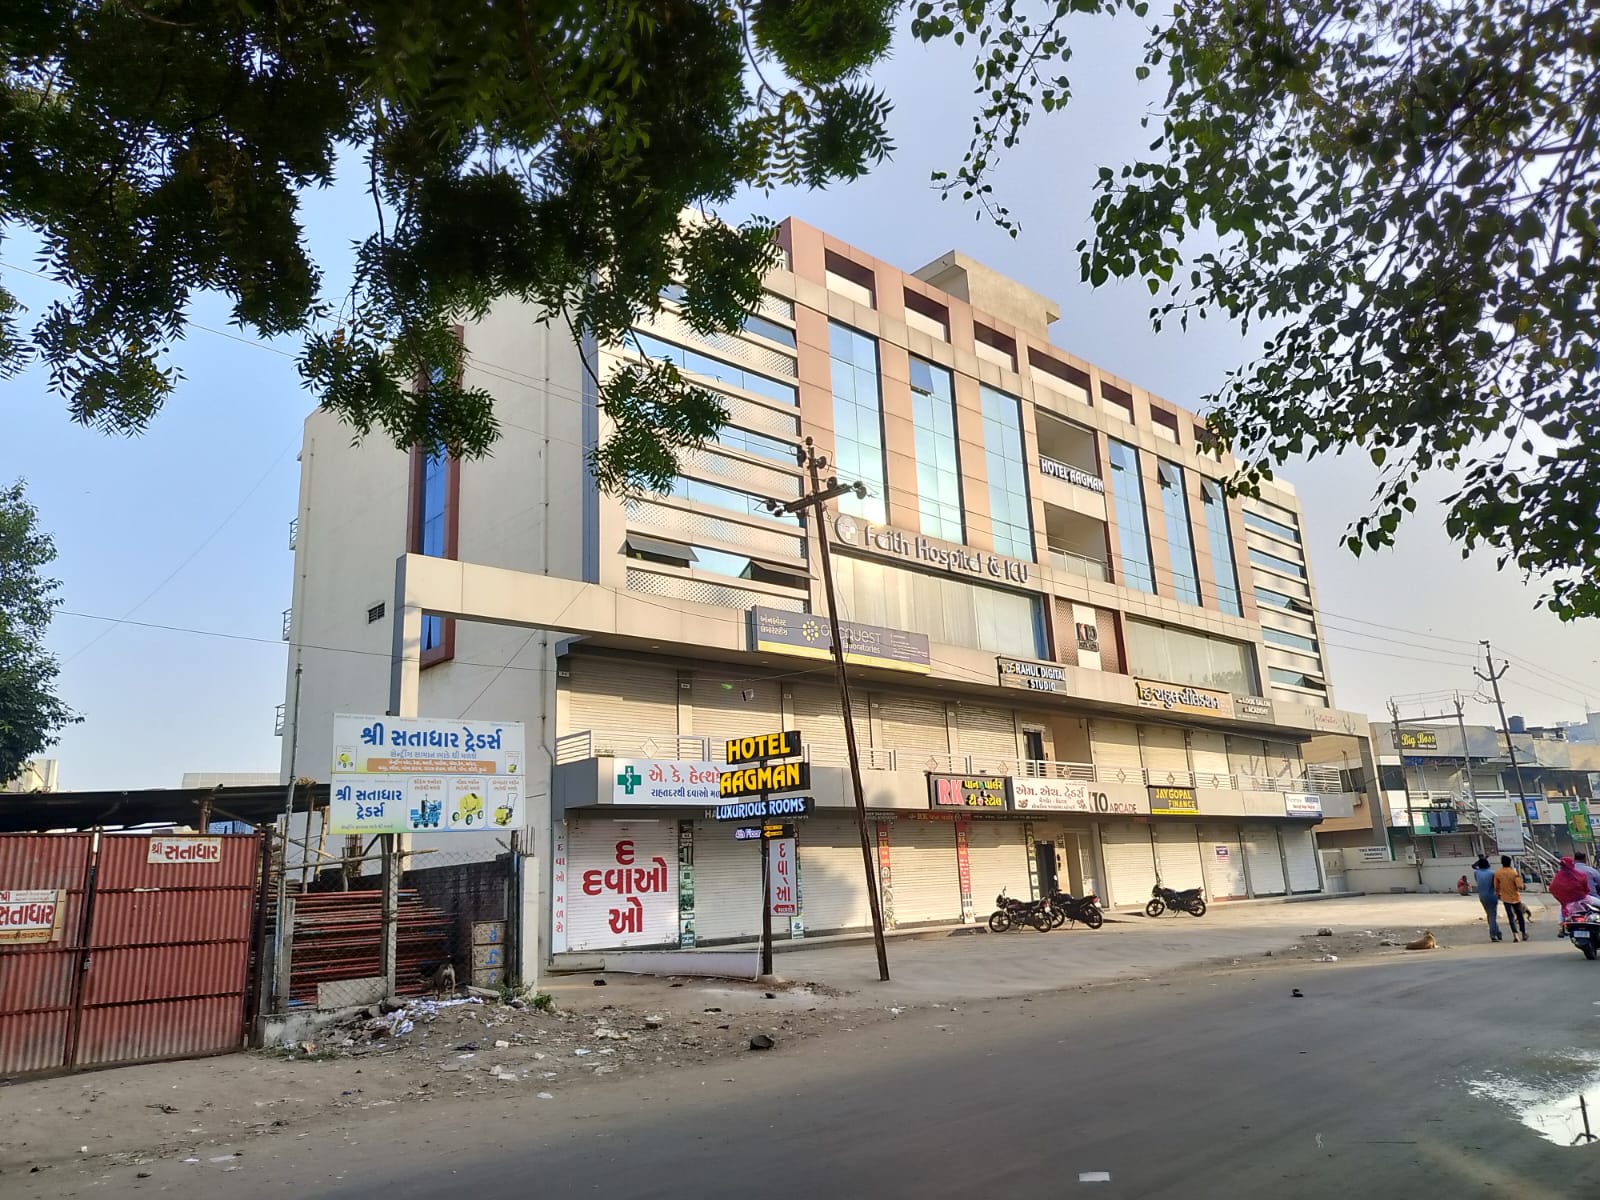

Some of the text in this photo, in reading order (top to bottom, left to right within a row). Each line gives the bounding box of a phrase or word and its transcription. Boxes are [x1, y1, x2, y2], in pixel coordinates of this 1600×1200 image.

[1041, 458, 1104, 493] HOTEL AAGMAN
[915, 537, 983, 573] Hospital
[988, 555, 1001, 578] &
[1004, 560, 1030, 583] ICU
[1015, 663, 1041, 678] RAHUL
[1041, 667, 1066, 681] DIGITAL
[1030, 680, 1056, 691] STUDIO
[360, 723, 503, 752] શ્રી સતાધાર ટ્રેડર્સ
[1402, 732, 1436, 748] Big Boss
[727, 732, 791, 764] HOTEL
[649, 764, 667, 783] એ.
[670, 764, 685, 783] કે.
[720, 762, 800, 794] AAGMAN
[335, 785, 402, 801] શ્રી સતાધાર
[687, 787, 709, 798] દવાઓ
[937, 778, 964, 805] RK
[964, 780, 979, 790] પાન
[1156, 789, 1192, 800] JAY GOPAL
[1168, 799, 1196, 808] FINANCE
[356, 802, 386, 820] ટ્રેડર્સ
[716, 802, 766, 819] LUXURIOUS
[769, 798, 806, 815] ROOMS
[1109, 802, 1137, 814] ARCADE
[152, 842, 218, 860] શ્રી સતાધાર
[582, 857, 668, 896] દવાઓ
